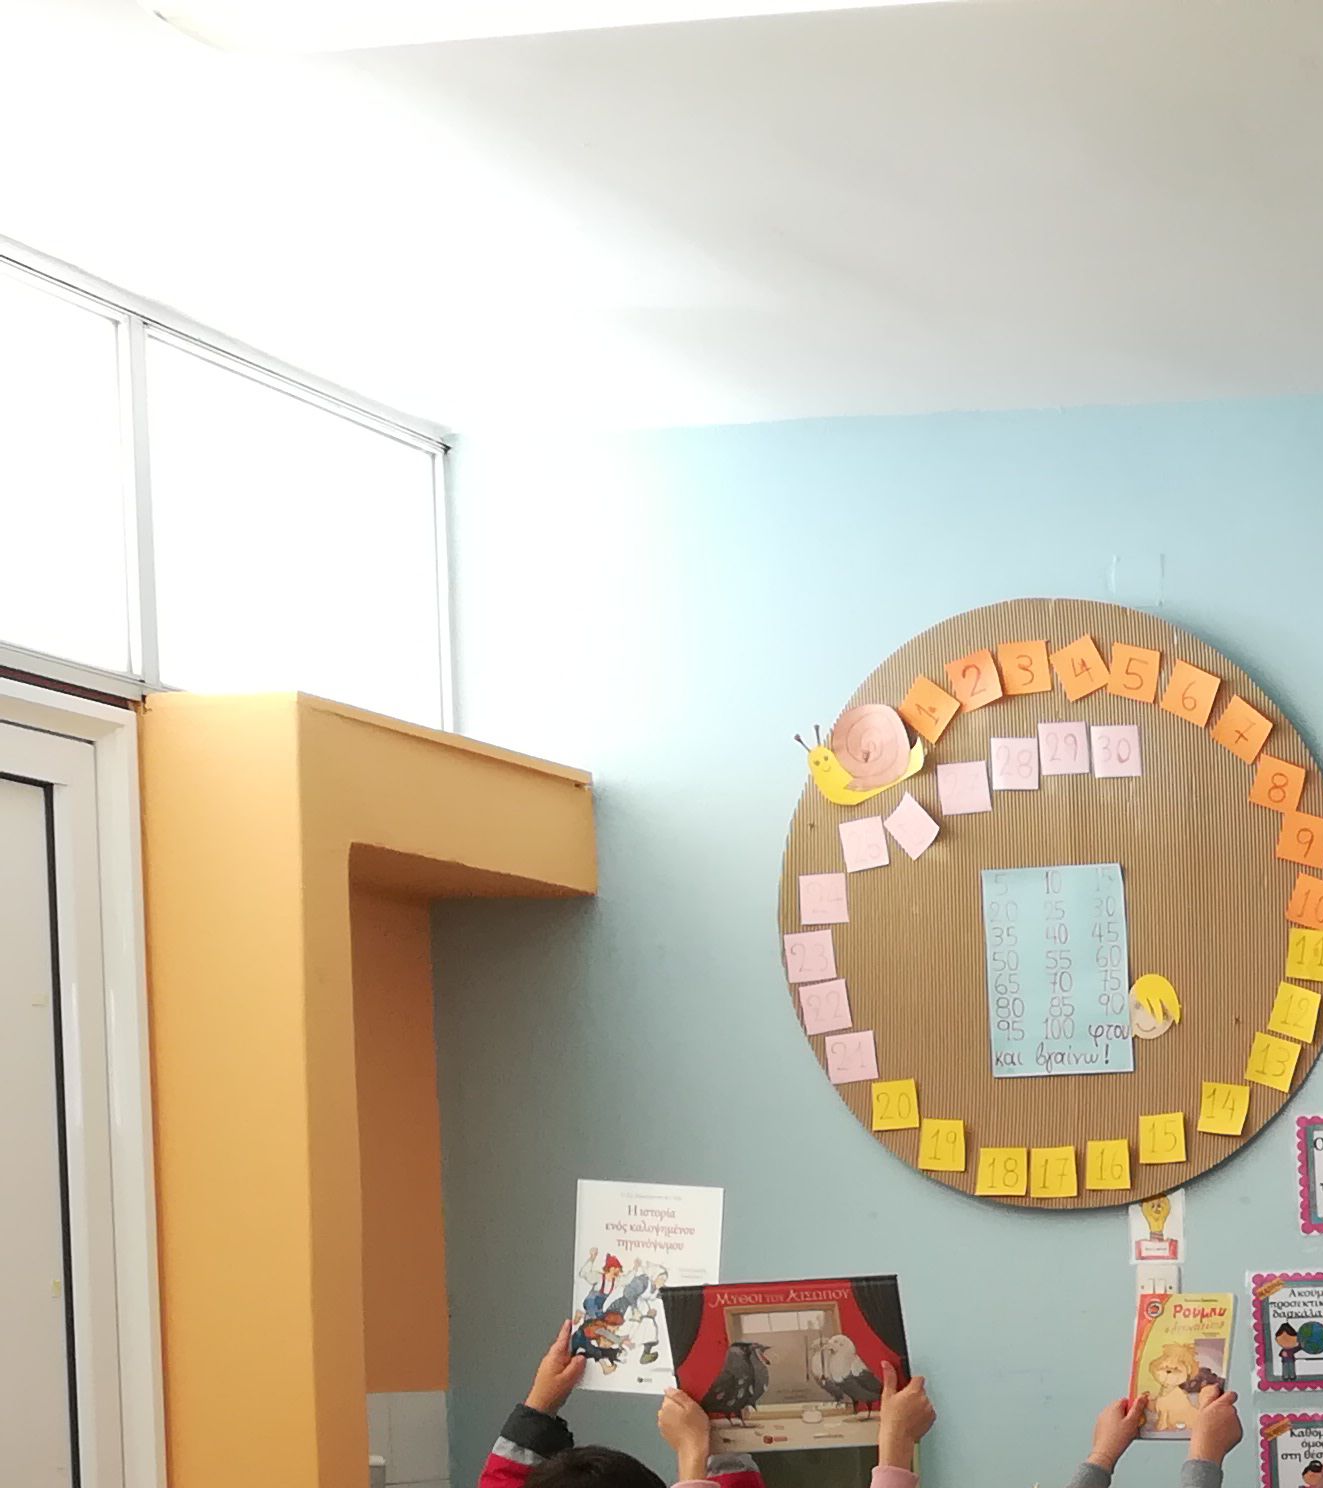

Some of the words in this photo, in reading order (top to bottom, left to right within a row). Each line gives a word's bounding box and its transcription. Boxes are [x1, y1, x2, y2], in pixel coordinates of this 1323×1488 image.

[961, 664, 987, 697] 2
[1016, 654, 1035, 685] 3
[1070, 658, 1094, 682] 4
[1123, 657, 1149, 691] 5
[1181, 680, 1197, 712] 6
[915, 704, 940, 725] 1
[1048, 732, 1079, 762] 29
[1233, 720, 1257, 744] 7
[999, 748, 1033, 778] 28
[1099, 735, 1131, 764] 30
[1268, 772, 1289, 803] 8
[1296, 827, 1314, 858] 9
[1045, 870, 1062, 894] 10
[991, 926, 1018, 946] 35
[1045, 923, 1068, 944] 40
[1092, 921, 1119, 942] 45
[992, 950, 1019, 971] 50
[1045, 950, 1072, 969] 55
[1096, 945, 1121, 968] 60
[993, 973, 1020, 995] 65
[1049, 971, 1073, 992] 70
[1101, 969, 1121, 991] 75
[996, 996, 1024, 1019] 80
[1050, 996, 1075, 1017] 85
[1099, 993, 1125, 1016] 90
[1281, 994, 1310, 1028] 12
[997, 1020, 1024, 1041] 95
[1044, 1017, 1075, 1040] 100
[1088, 1023, 1130, 1047] φτου
[994, 1050, 1023, 1067] και
[1255, 1043, 1291, 1078] 13
[875, 1092, 912, 1121] 20
[1205, 1087, 1236, 1121] 14
[929, 1129, 957, 1163] 19
[1149, 1121, 1178, 1154] 15
[988, 1157, 1020, 1189] 18
[1040, 1157, 1068, 1189] 17
[1097, 1150, 1123, 1182] 16
[640, 1208, 676, 1221] ιστορία
